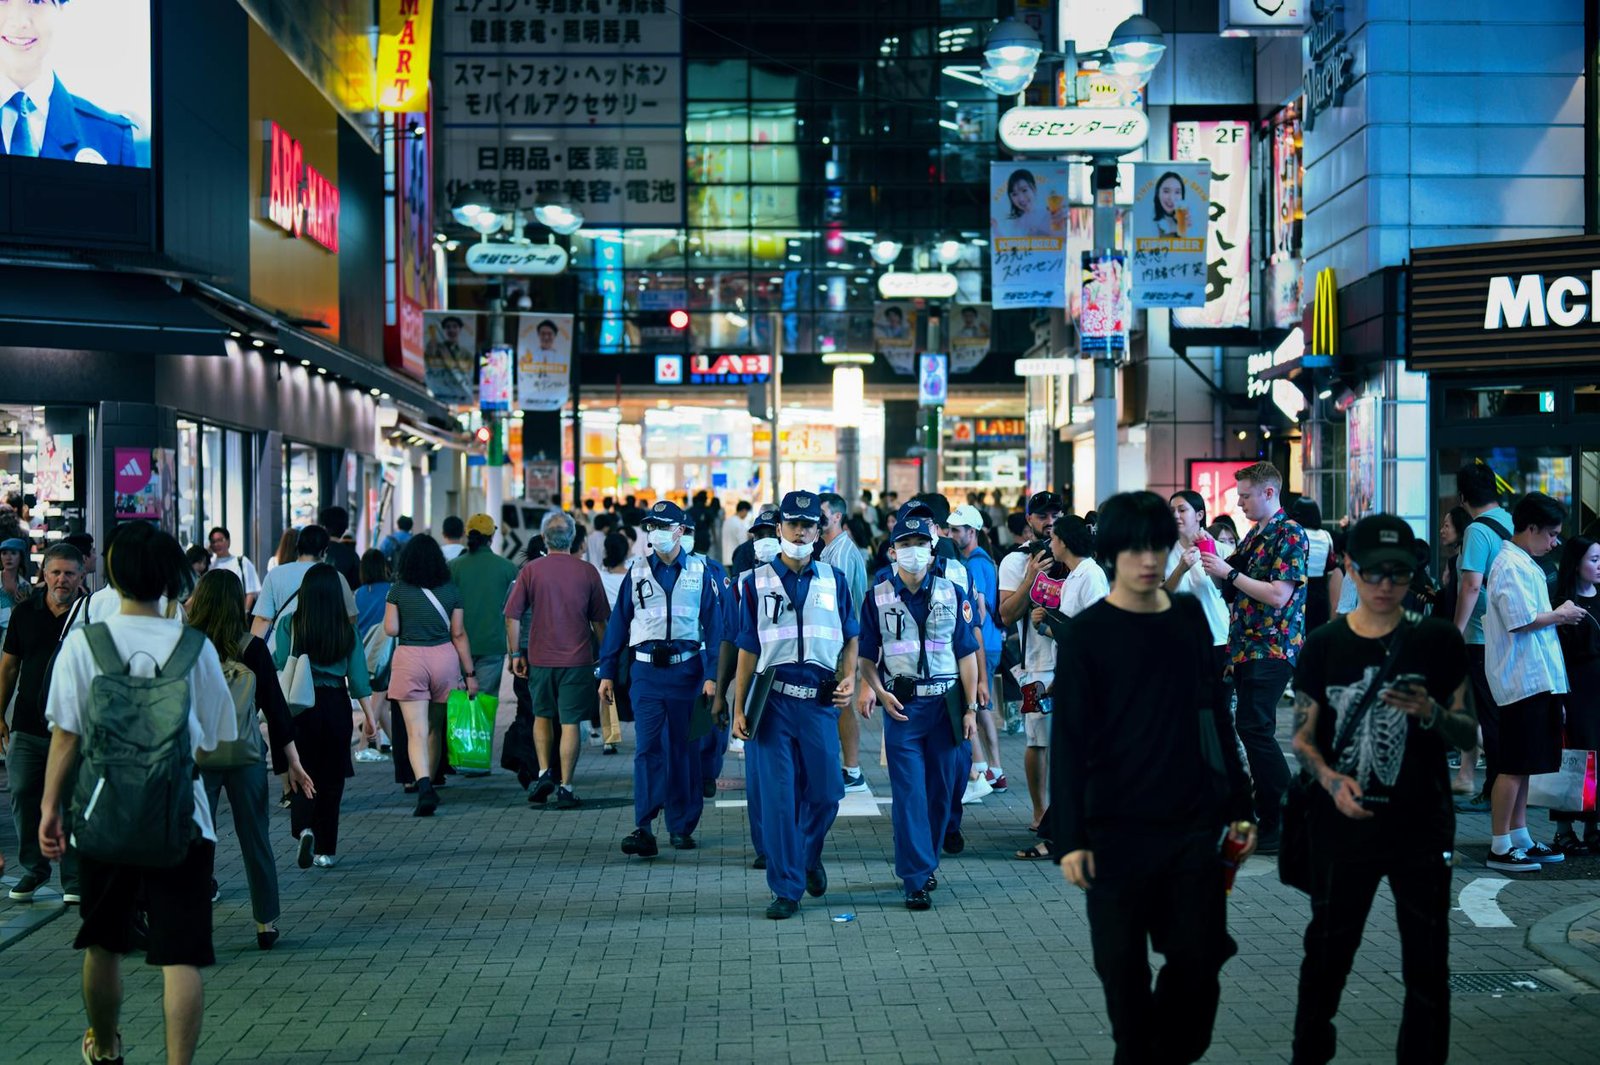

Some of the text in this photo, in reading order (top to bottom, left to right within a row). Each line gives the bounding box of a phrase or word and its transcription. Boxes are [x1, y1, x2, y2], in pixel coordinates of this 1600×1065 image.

[470, 20, 641, 44] 健康家電・照明器具
[454, 63, 667, 86] スマートフォン・ヘッドホン
[465, 94, 658, 116] モバイルアクセサリー
[1216, 128, 1244, 143] 2F
[477, 147, 648, 171] 日用品・医薬品
[269, 120, 340, 254] ABC-MART
